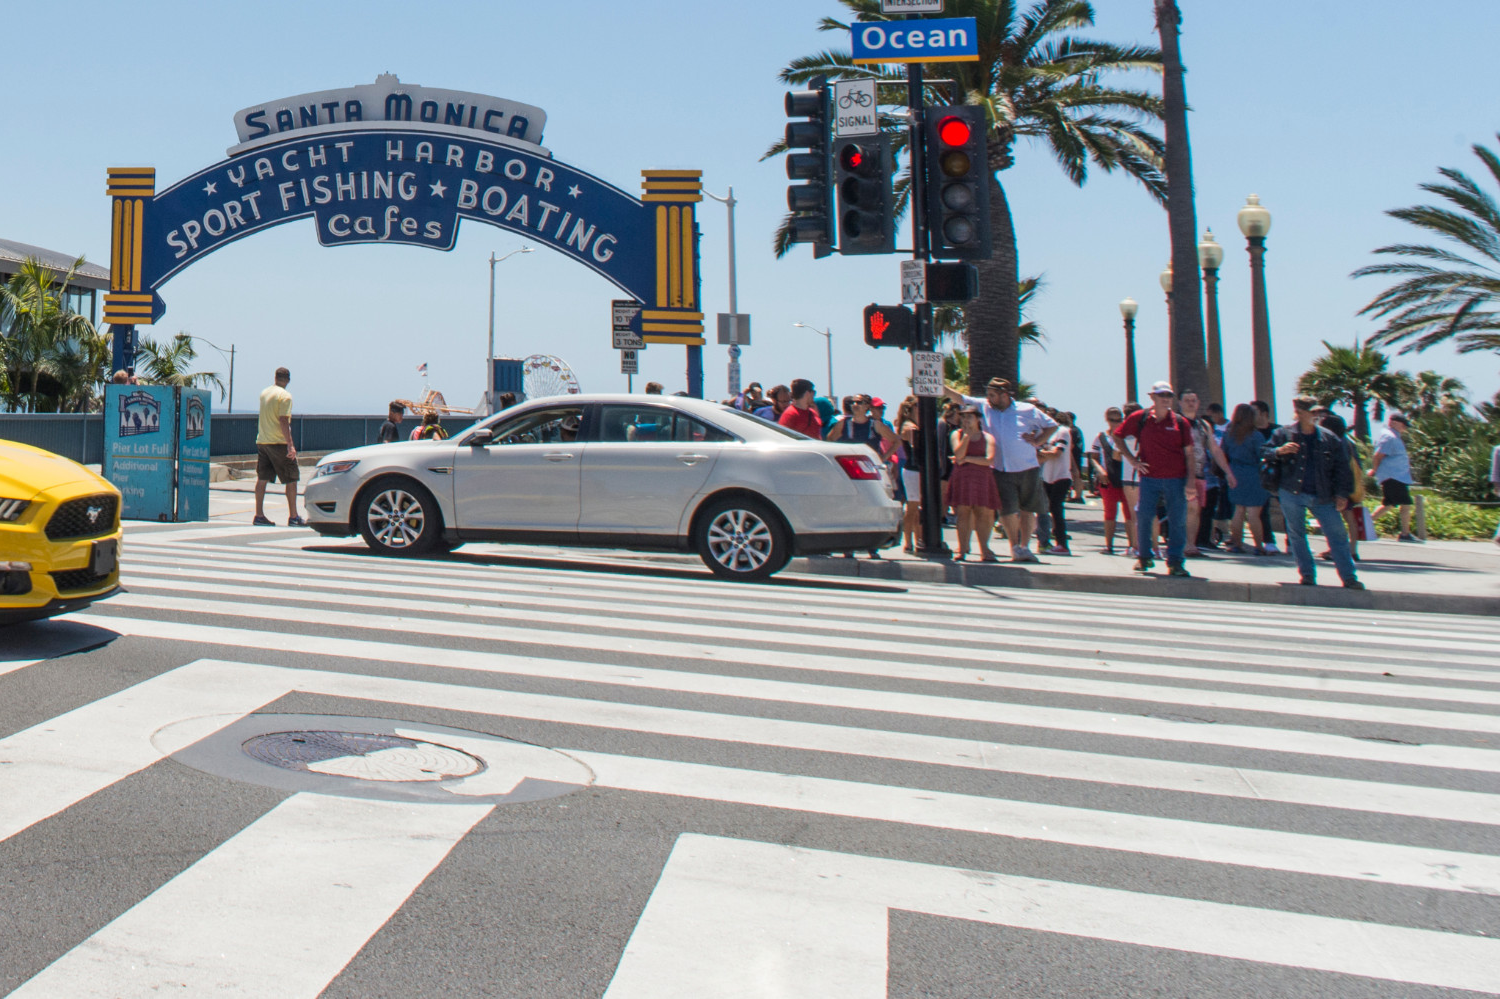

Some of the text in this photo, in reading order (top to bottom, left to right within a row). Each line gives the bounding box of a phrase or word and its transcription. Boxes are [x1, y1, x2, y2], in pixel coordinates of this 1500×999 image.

[862, 27, 968, 50] Ocean
[245, 93, 530, 141] SANTA MONICA
[838, 116, 875, 128] SIGNAL
[227, 140, 555, 192] YACHT HARBOR
[166, 171, 618, 262] SPORT FISHING BOATING
[616, 338, 643, 346] 3 TONS
[624, 351, 635, 359] NO
[915, 353, 941, 362] CROSS
[918, 369, 938, 377] WALK
[915, 377, 942, 385] SIGNAL
[919, 385, 938, 393] ONLY
[112, 442, 169, 455] Pier Lot Full
[113, 461, 158, 471] Additional
[113, 472, 129, 482] Pier
[121, 486, 145, 497] rking
